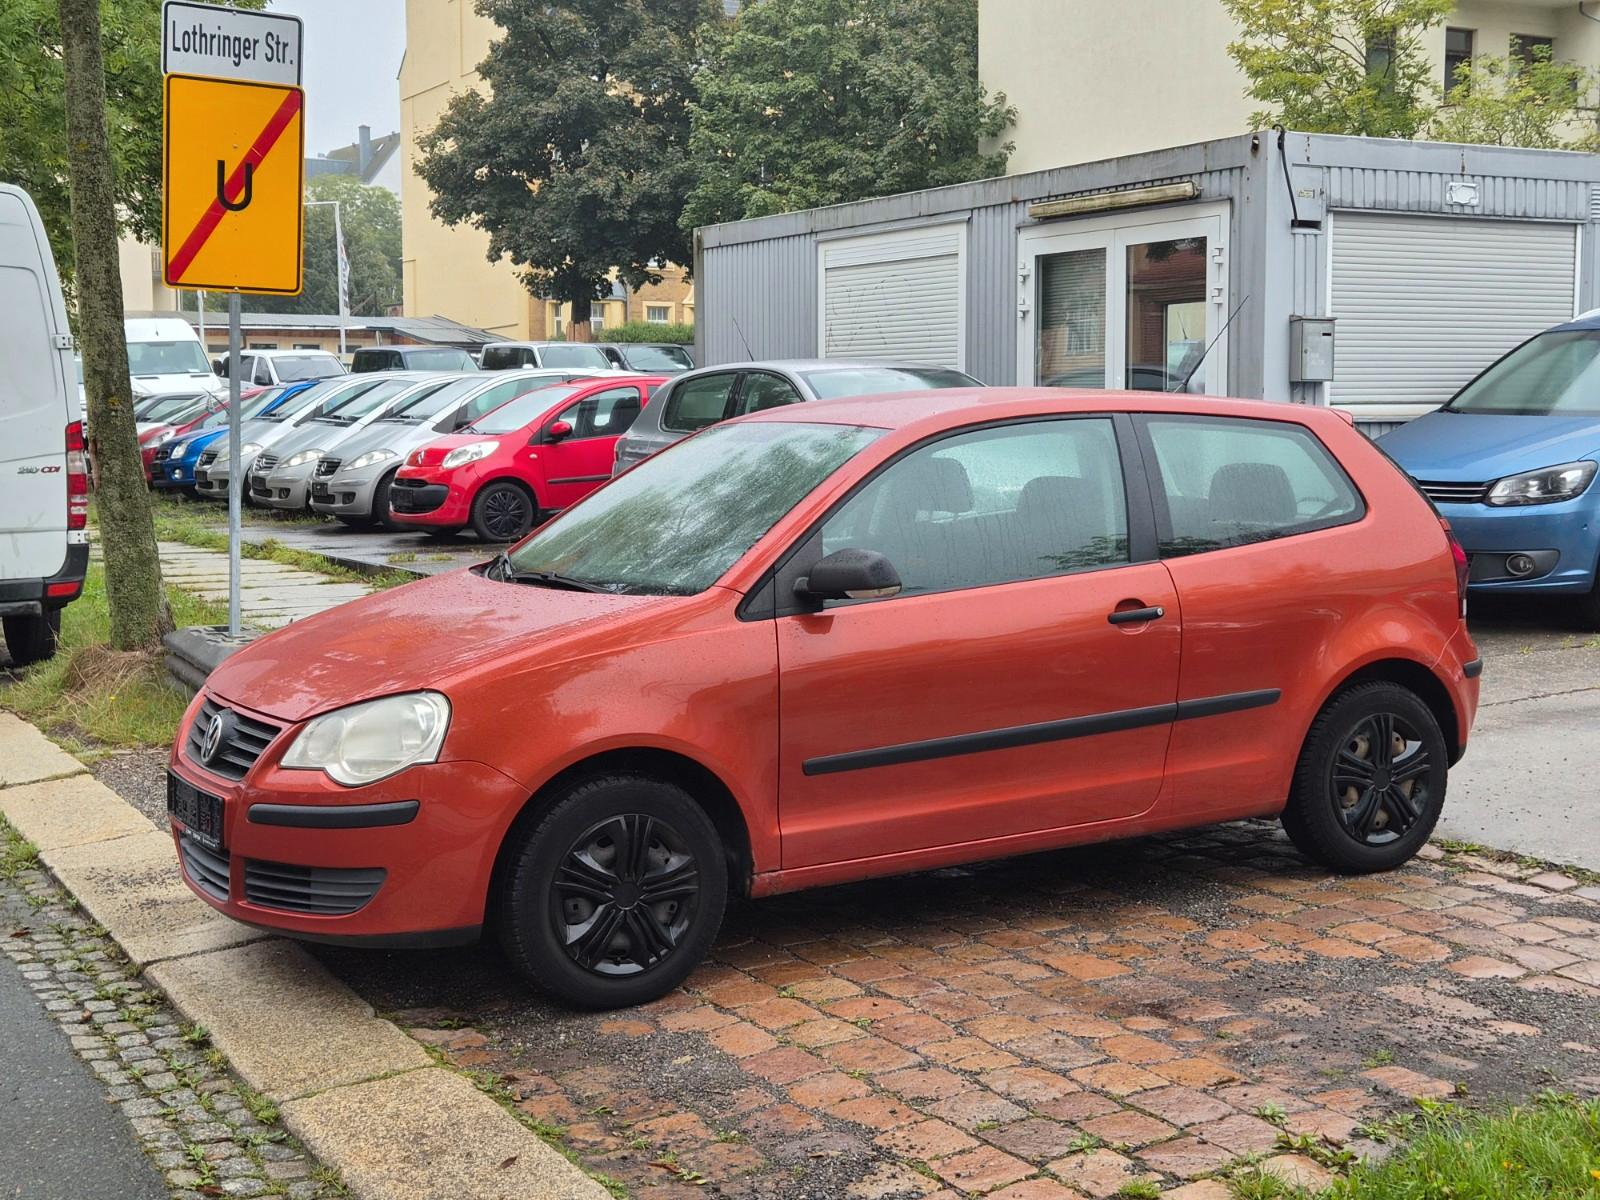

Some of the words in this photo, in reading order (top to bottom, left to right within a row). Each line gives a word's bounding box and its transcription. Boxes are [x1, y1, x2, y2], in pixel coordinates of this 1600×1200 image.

[172, 20, 260, 67] Lothringer
[264, 31, 293, 65] Str.
[216, 159, 253, 212] U
[40, 465, 61, 474] CDI
